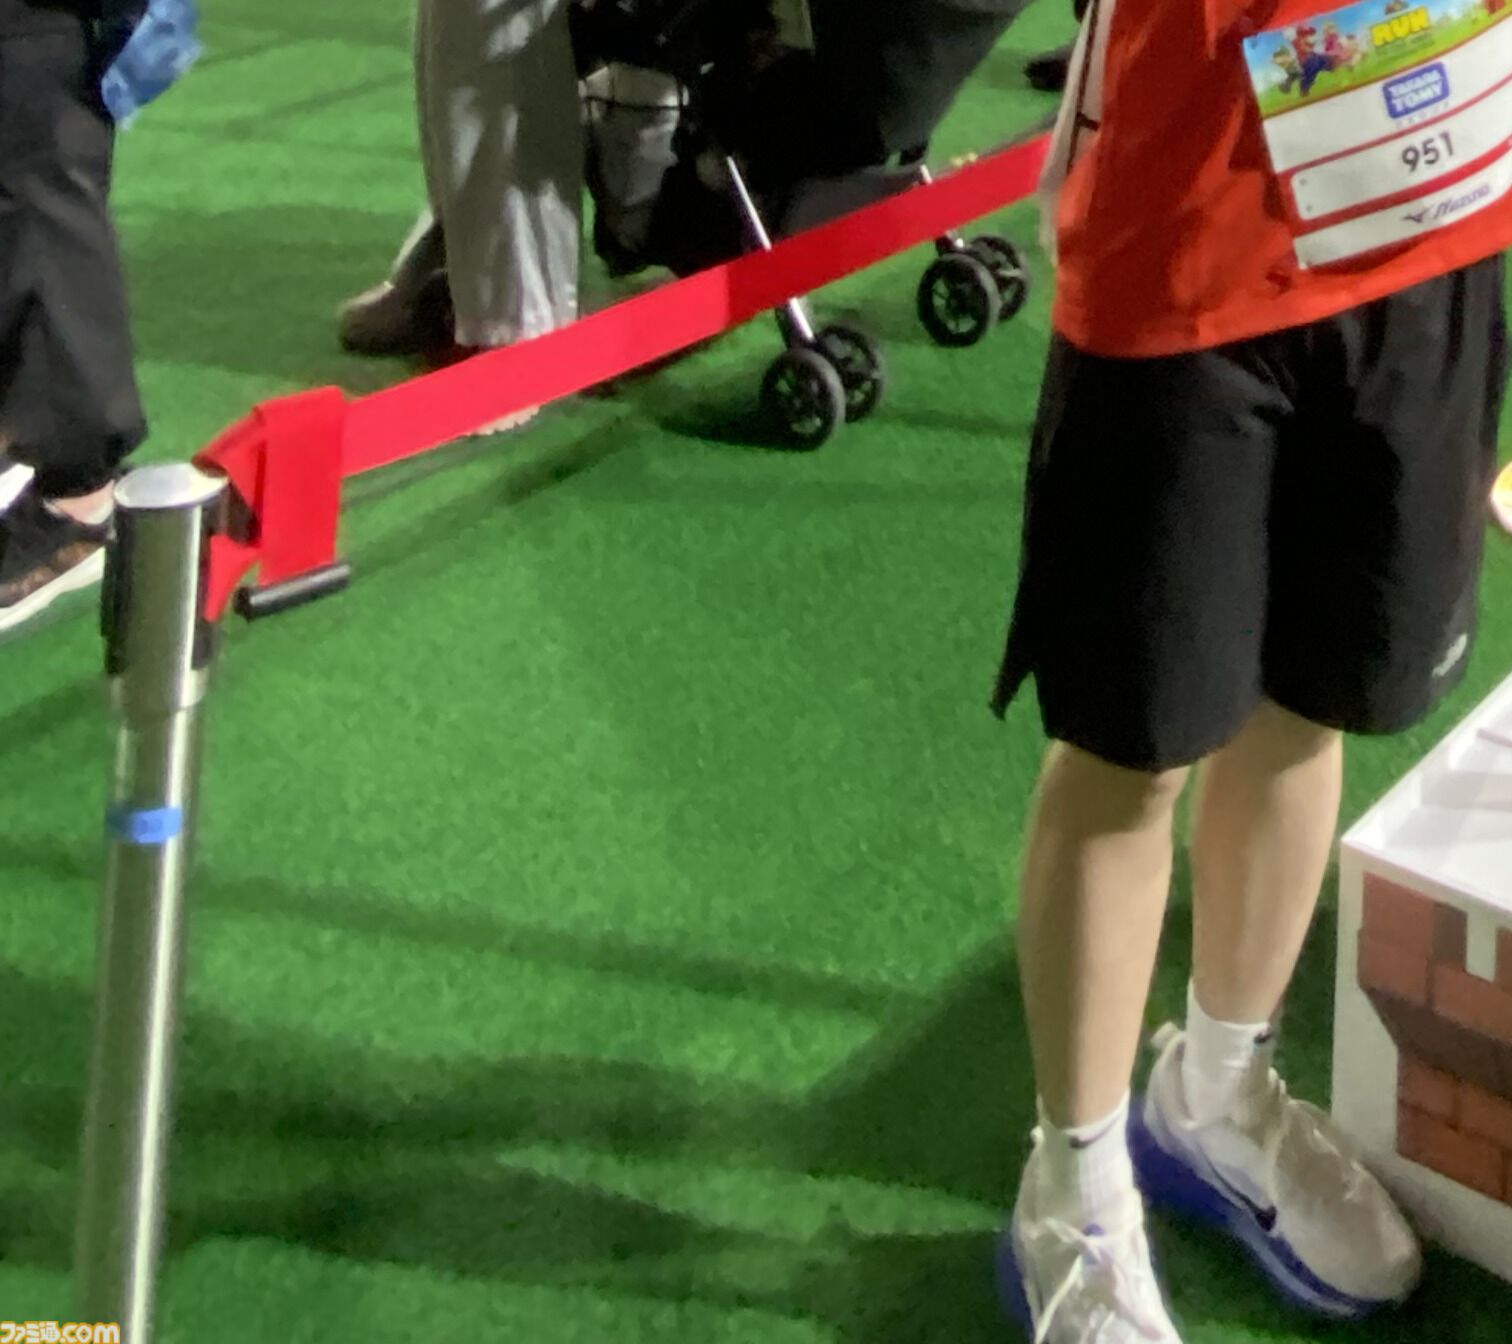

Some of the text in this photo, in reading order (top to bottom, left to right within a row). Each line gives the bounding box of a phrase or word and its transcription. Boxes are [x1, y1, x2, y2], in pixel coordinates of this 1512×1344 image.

[1371, 6, 1429, 47] RUN
[1391, 81, 1443, 113] TOMY
[1400, 131, 1454, 173] 951
